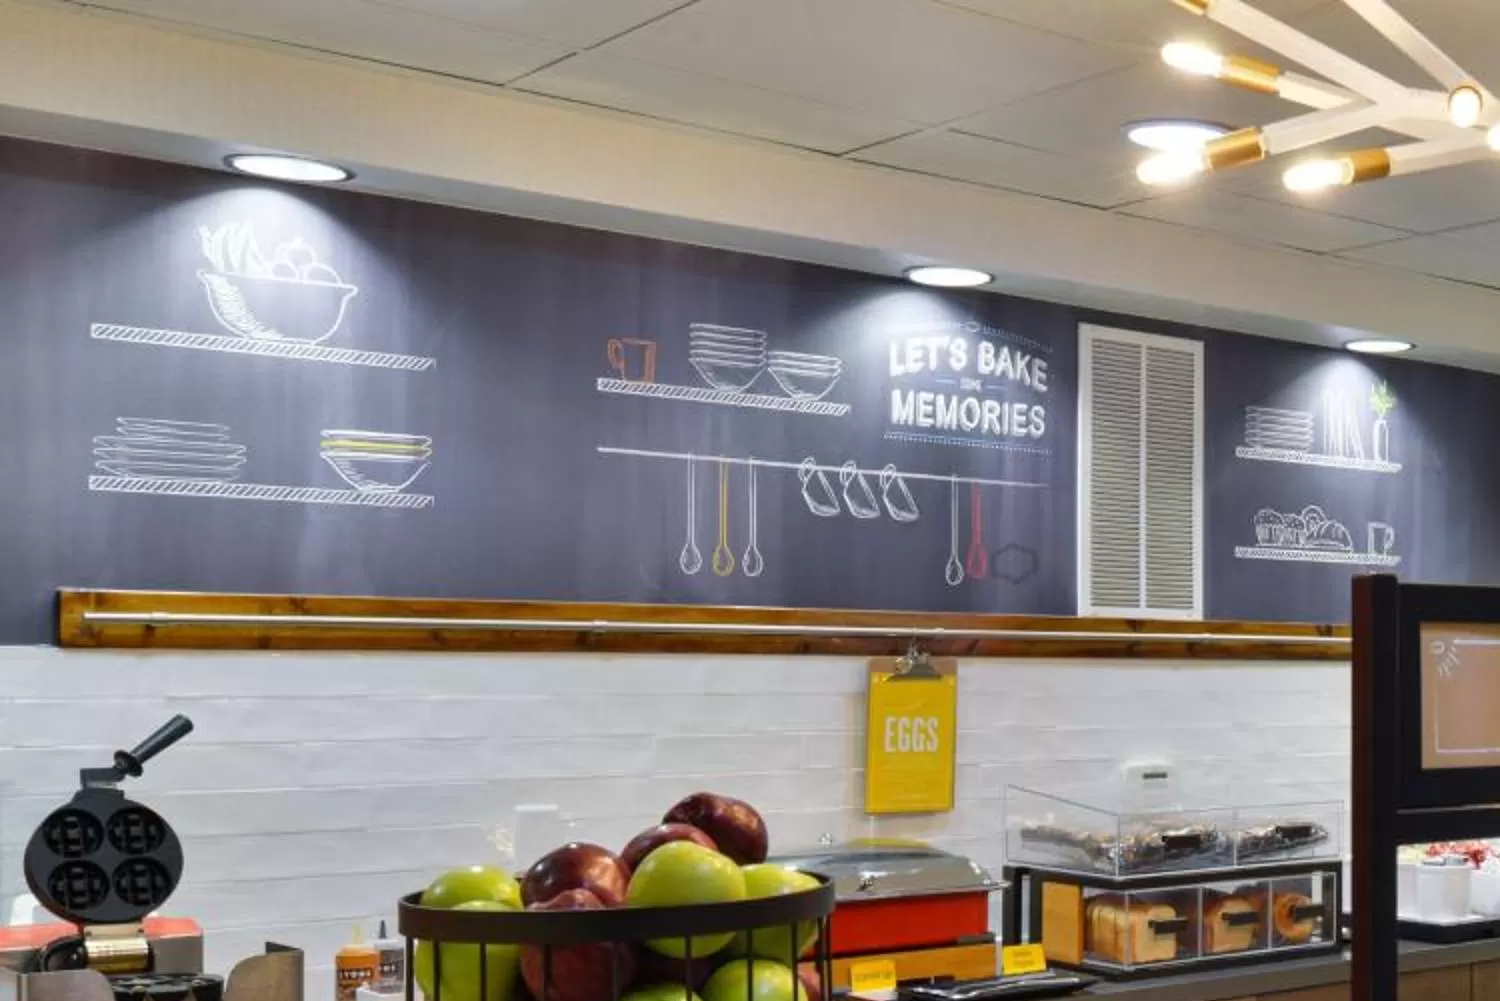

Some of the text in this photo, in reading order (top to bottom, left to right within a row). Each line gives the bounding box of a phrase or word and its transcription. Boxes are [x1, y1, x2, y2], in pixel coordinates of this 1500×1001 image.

[889, 336, 1048, 392] LET'S BAKE
[891, 389, 1046, 439] MEMORIES
[884, 715, 939, 753] EGGS
